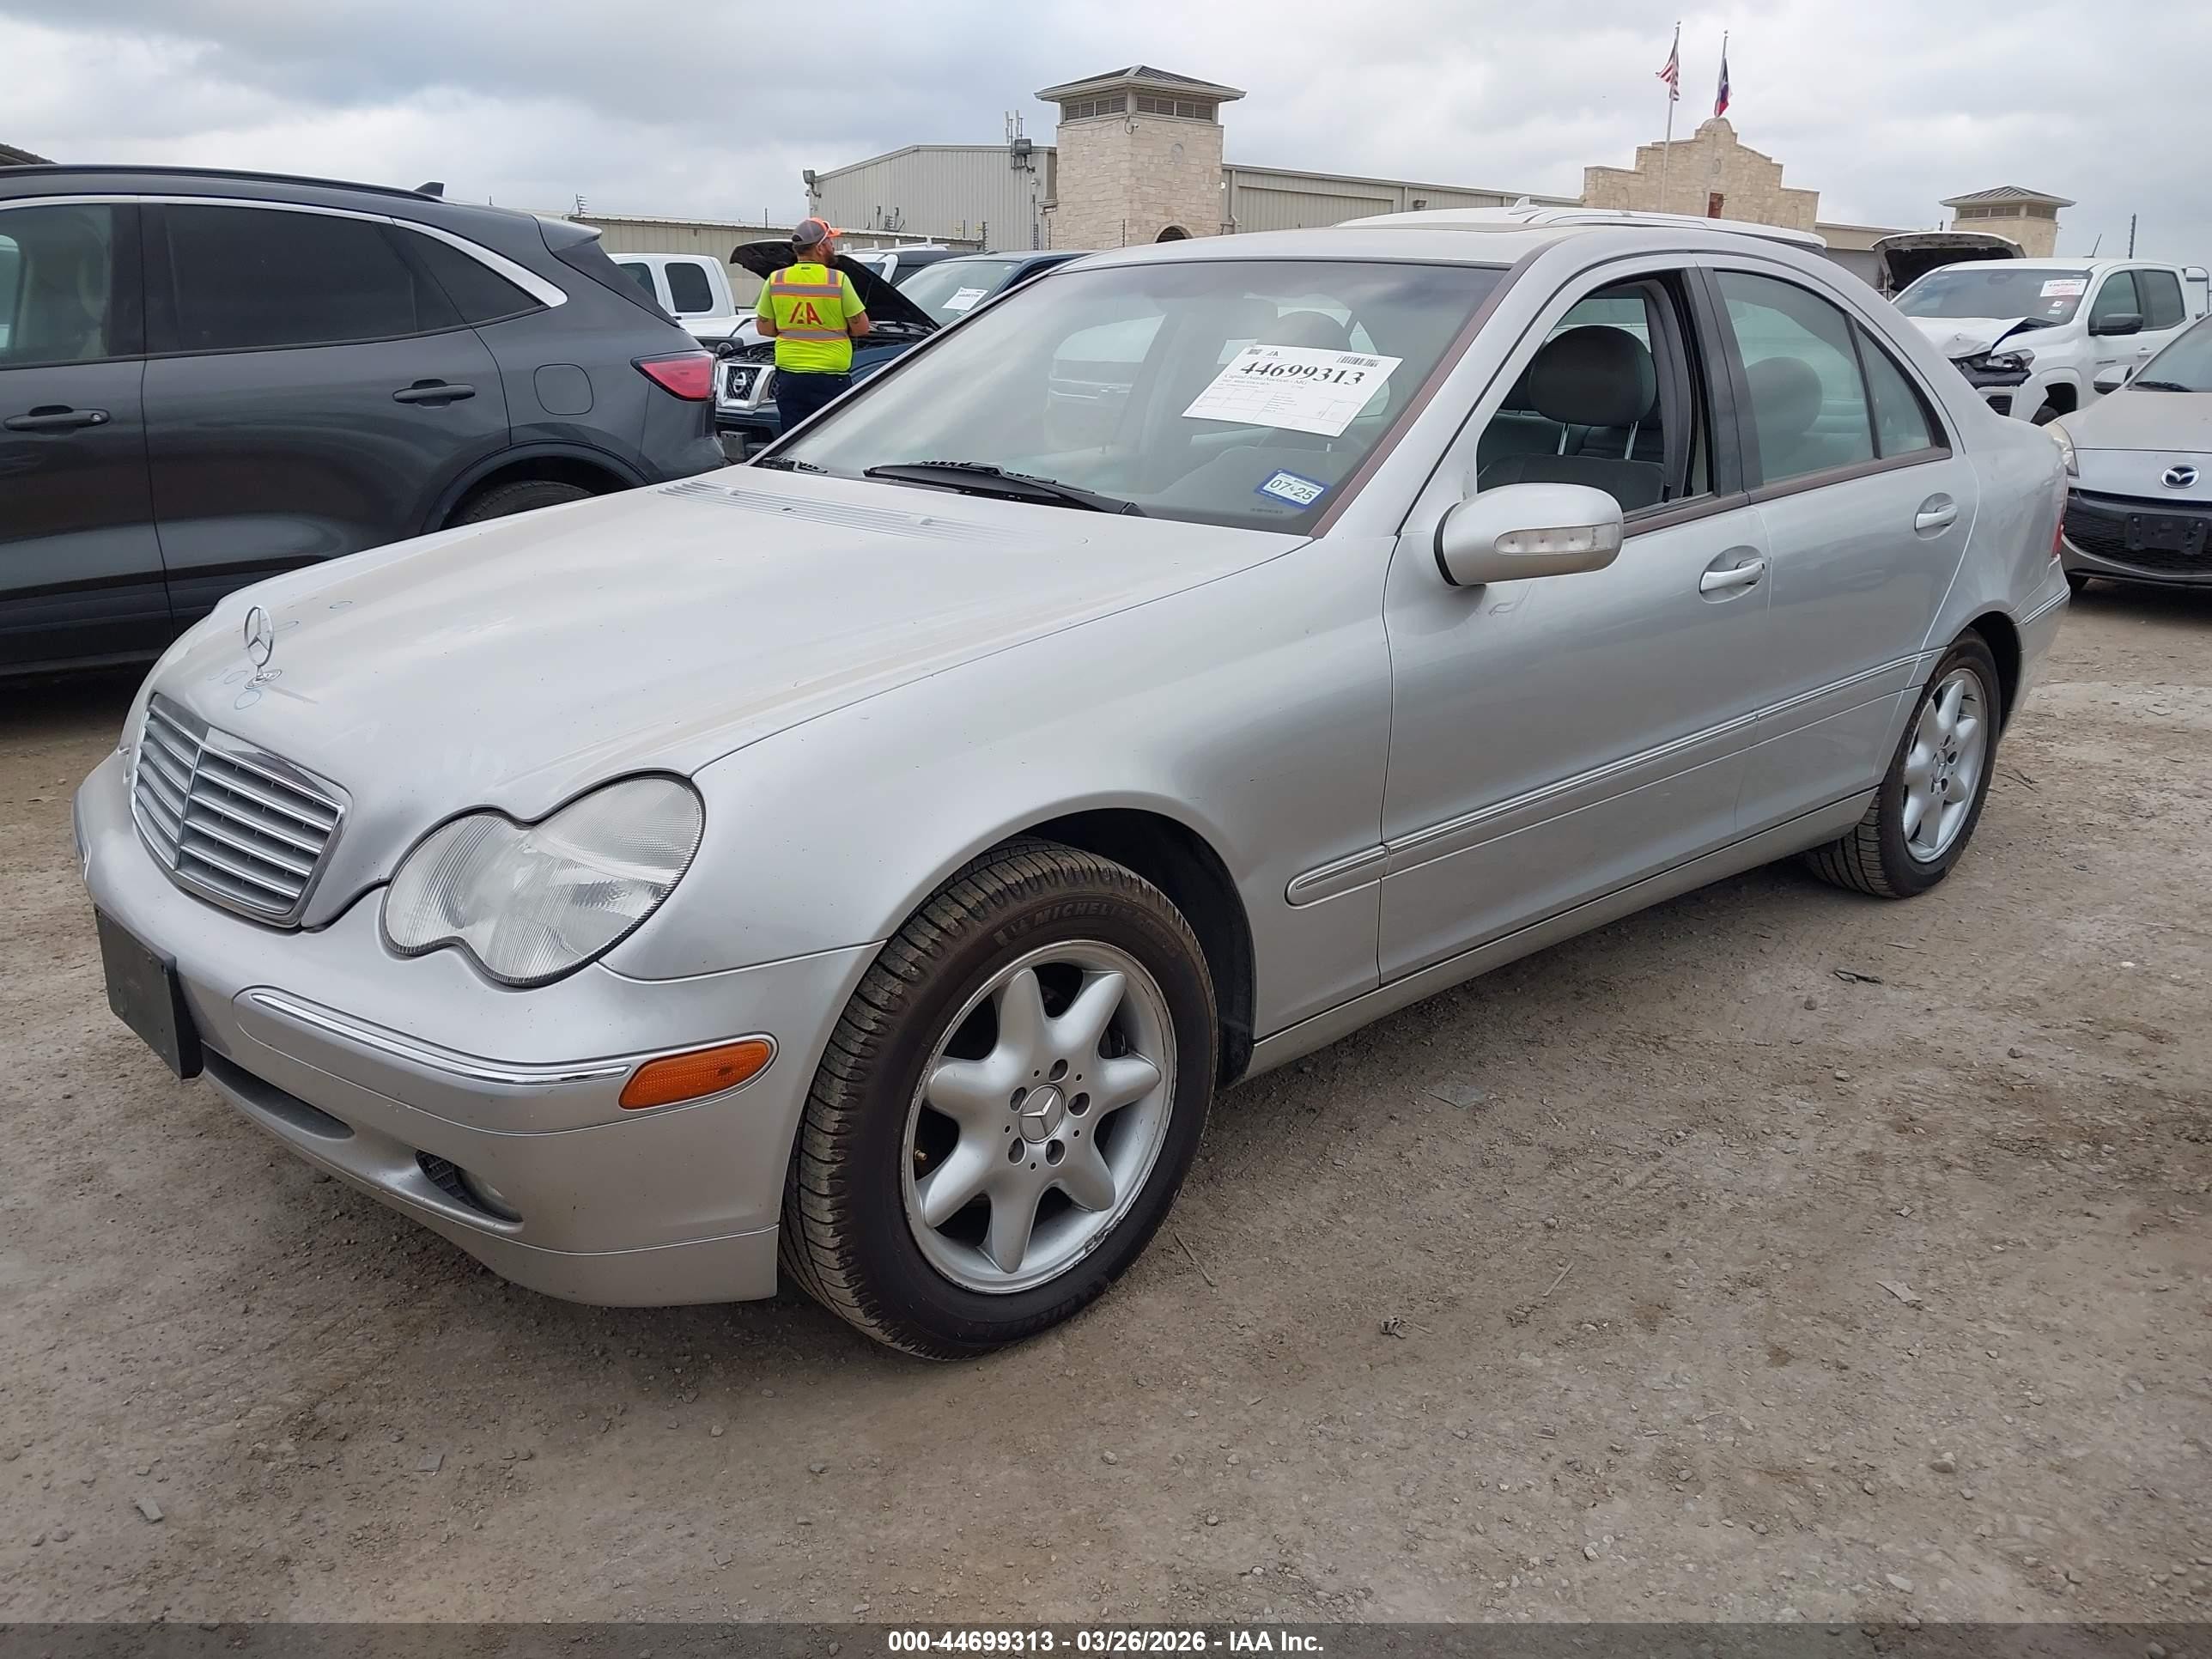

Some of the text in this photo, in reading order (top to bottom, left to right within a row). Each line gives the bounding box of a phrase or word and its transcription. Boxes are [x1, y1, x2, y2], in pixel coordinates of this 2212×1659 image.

[1240, 362, 1365, 386] 44699313
[1270, 479, 1292, 491] 07
[1292, 487, 1316, 500] 25
[1033, 902, 1133, 926] MICHELI
